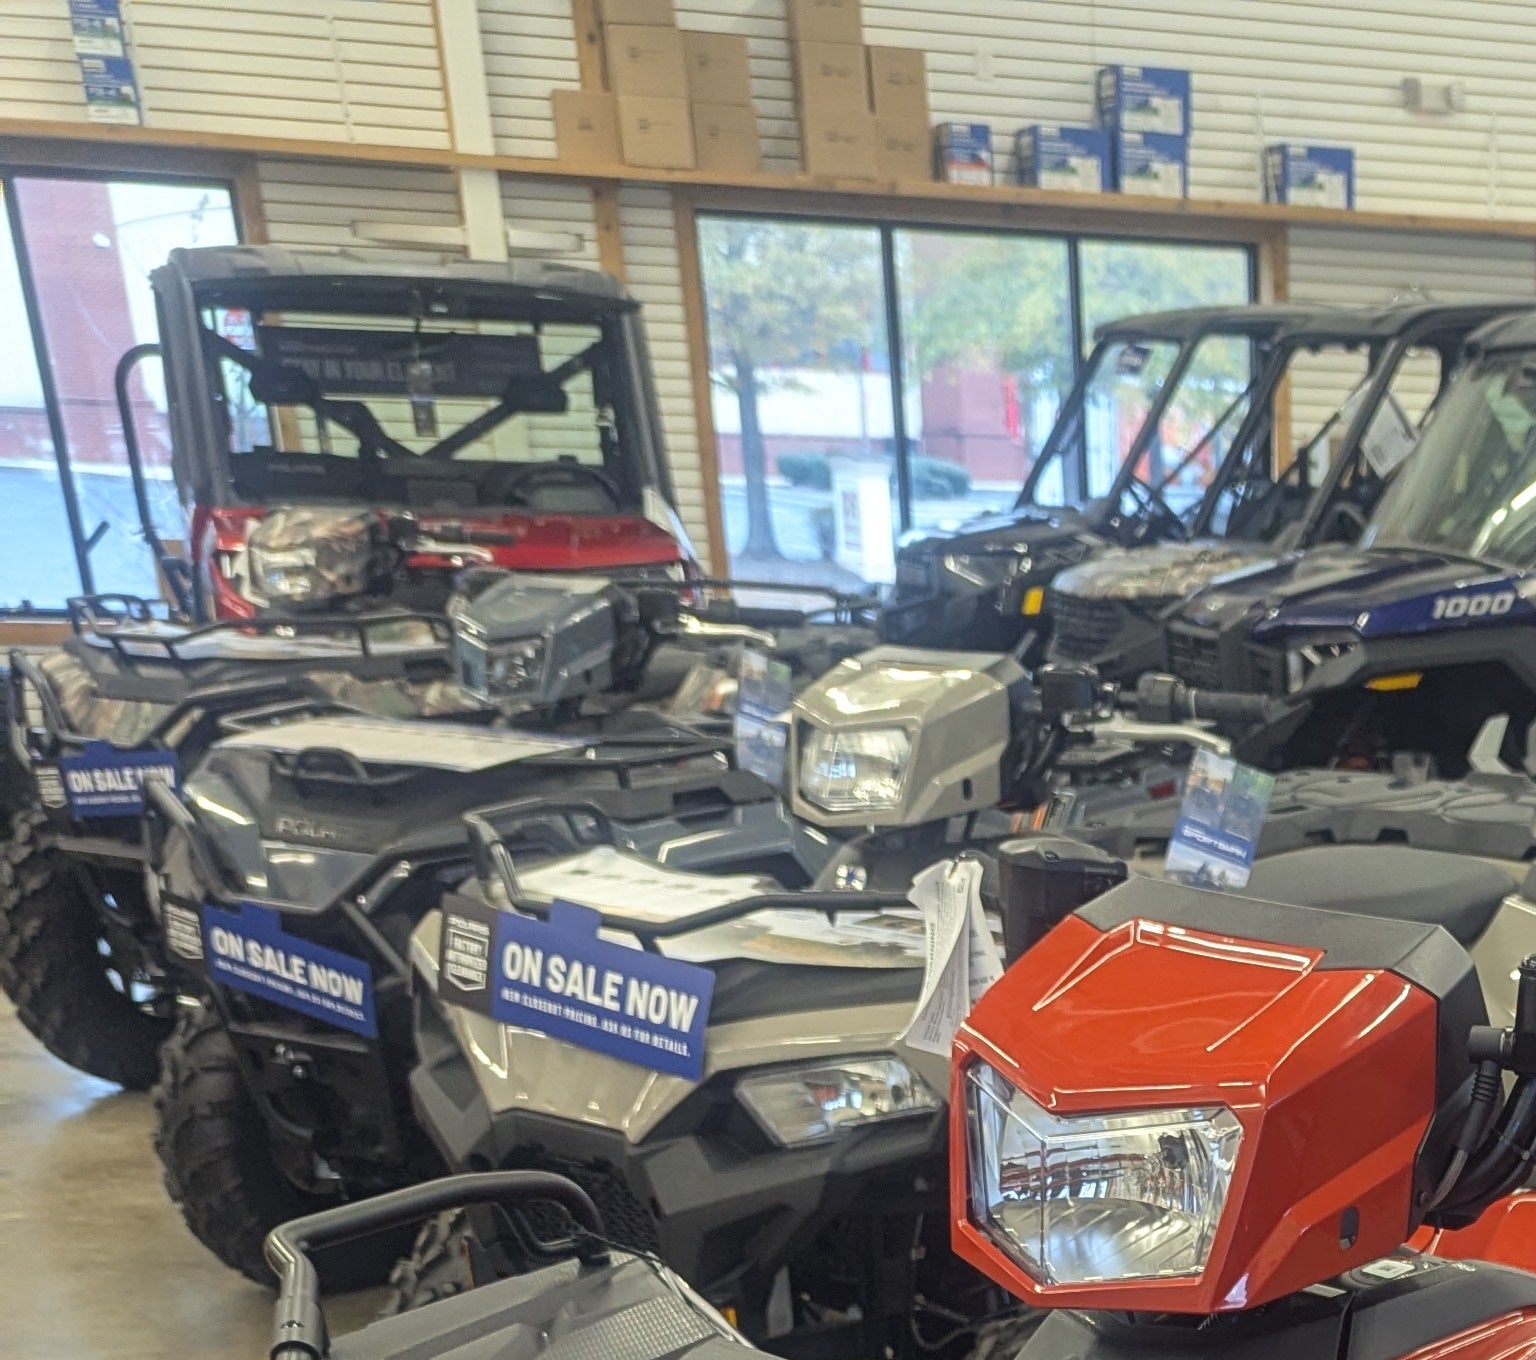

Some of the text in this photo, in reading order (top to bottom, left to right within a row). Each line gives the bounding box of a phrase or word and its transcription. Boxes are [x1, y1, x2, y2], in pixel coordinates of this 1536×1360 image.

[1432, 590, 1516, 620] 1000
[66, 770, 94, 793] ON
[93, 768, 139, 792] SALE
[210, 925, 246, 962] ON
[245, 938, 308, 986] SALE
[306, 961, 364, 1006] NOW
[503, 940, 700, 1034] ON SALE NOW
